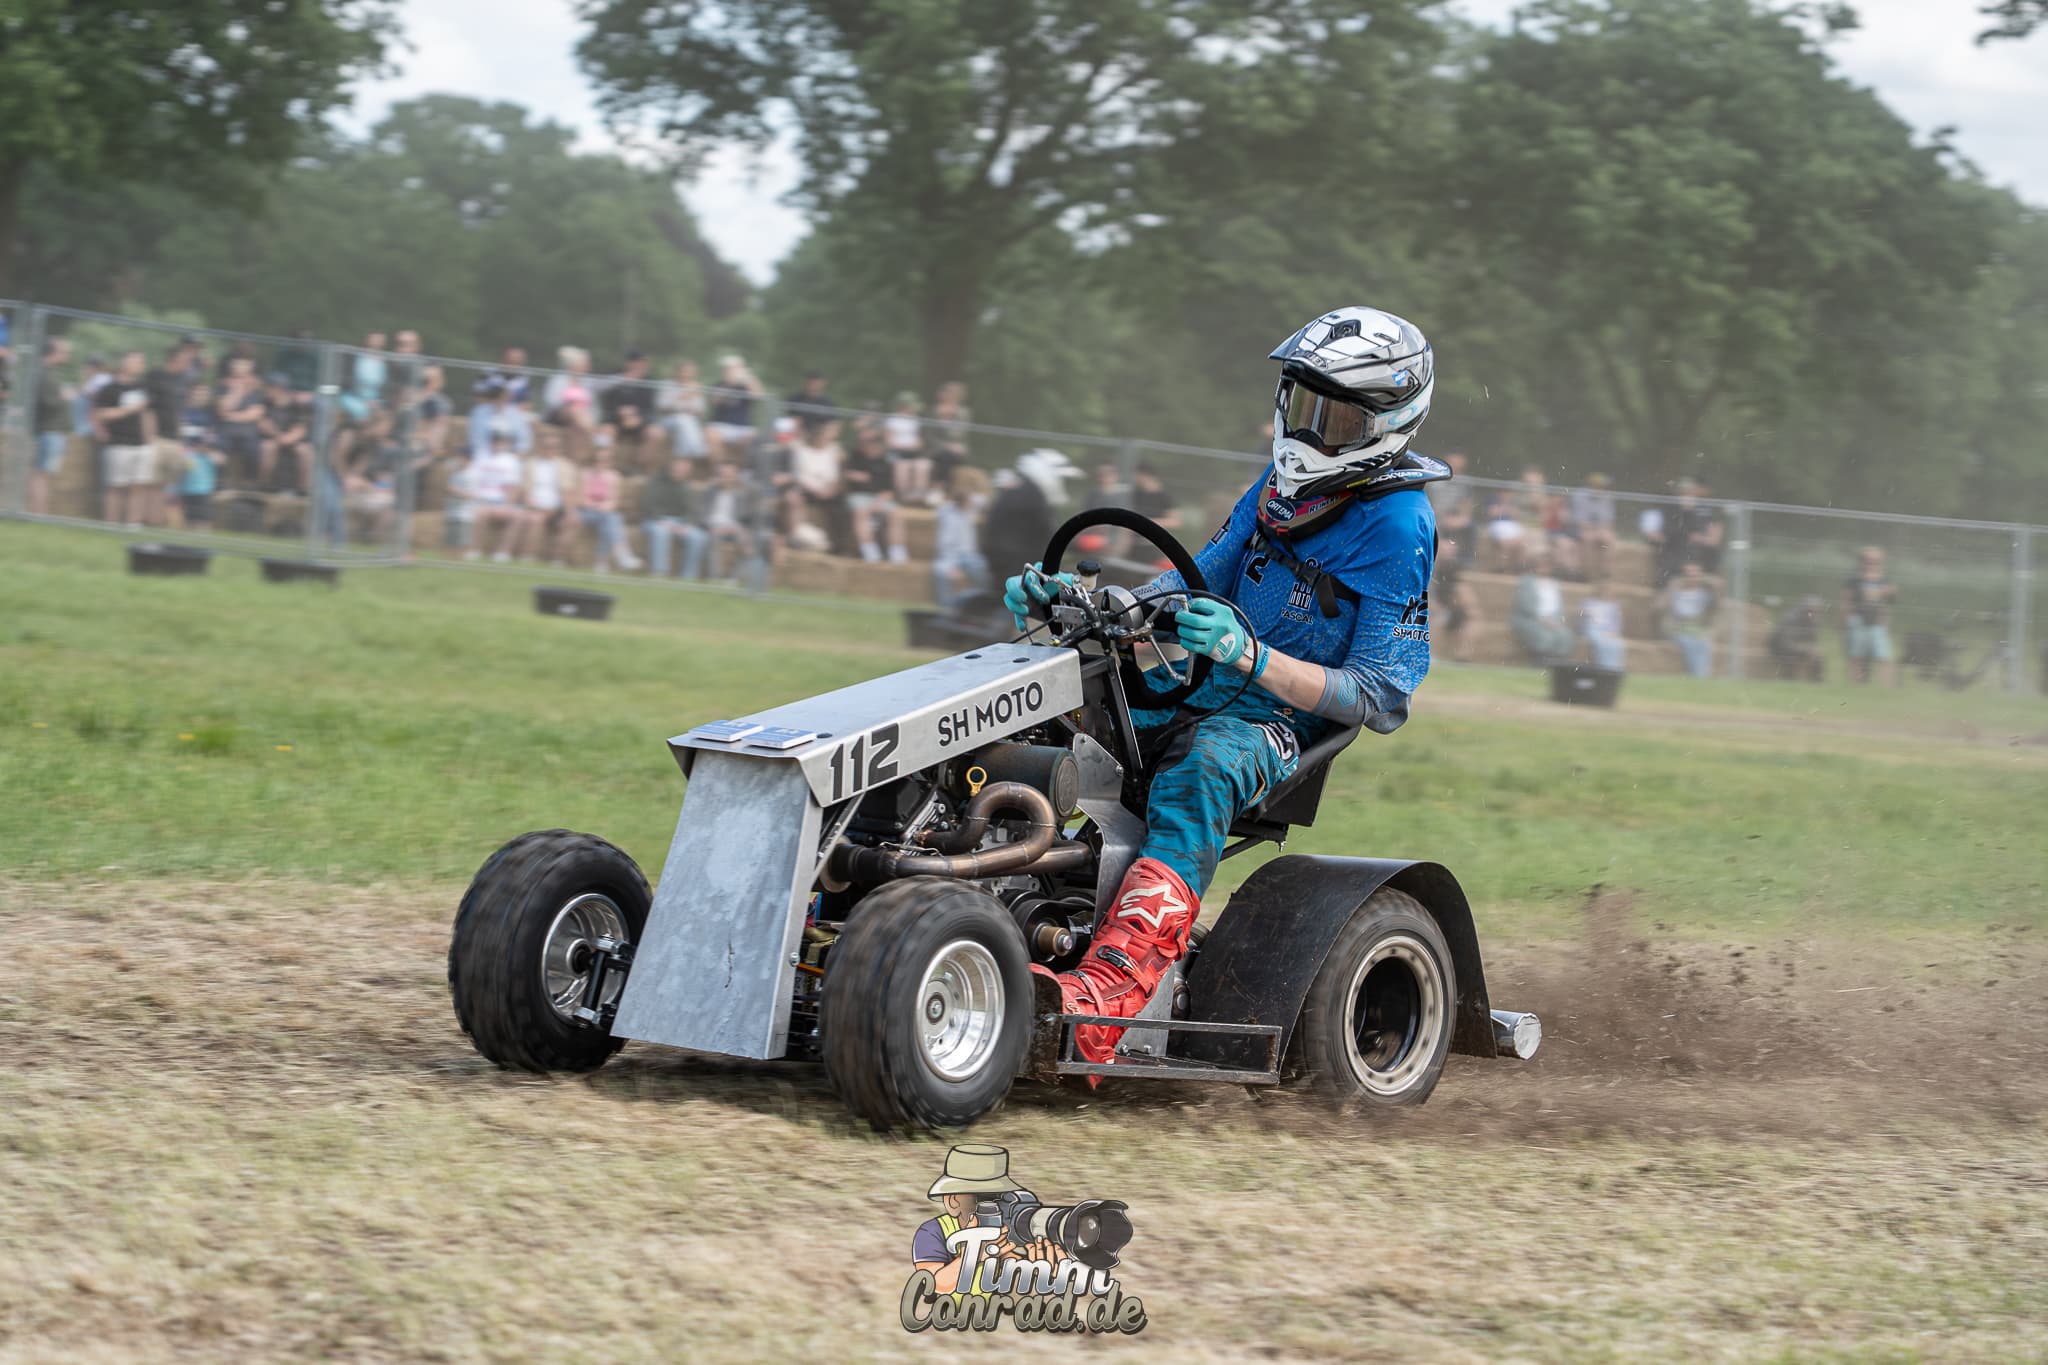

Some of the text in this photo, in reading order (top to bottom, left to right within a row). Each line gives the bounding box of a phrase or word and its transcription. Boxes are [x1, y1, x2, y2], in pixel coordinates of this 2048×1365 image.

[1267, 500, 1294, 520] ORTEMA
[938, 681, 1043, 747] SH MOTO
[830, 723, 899, 801] 112
